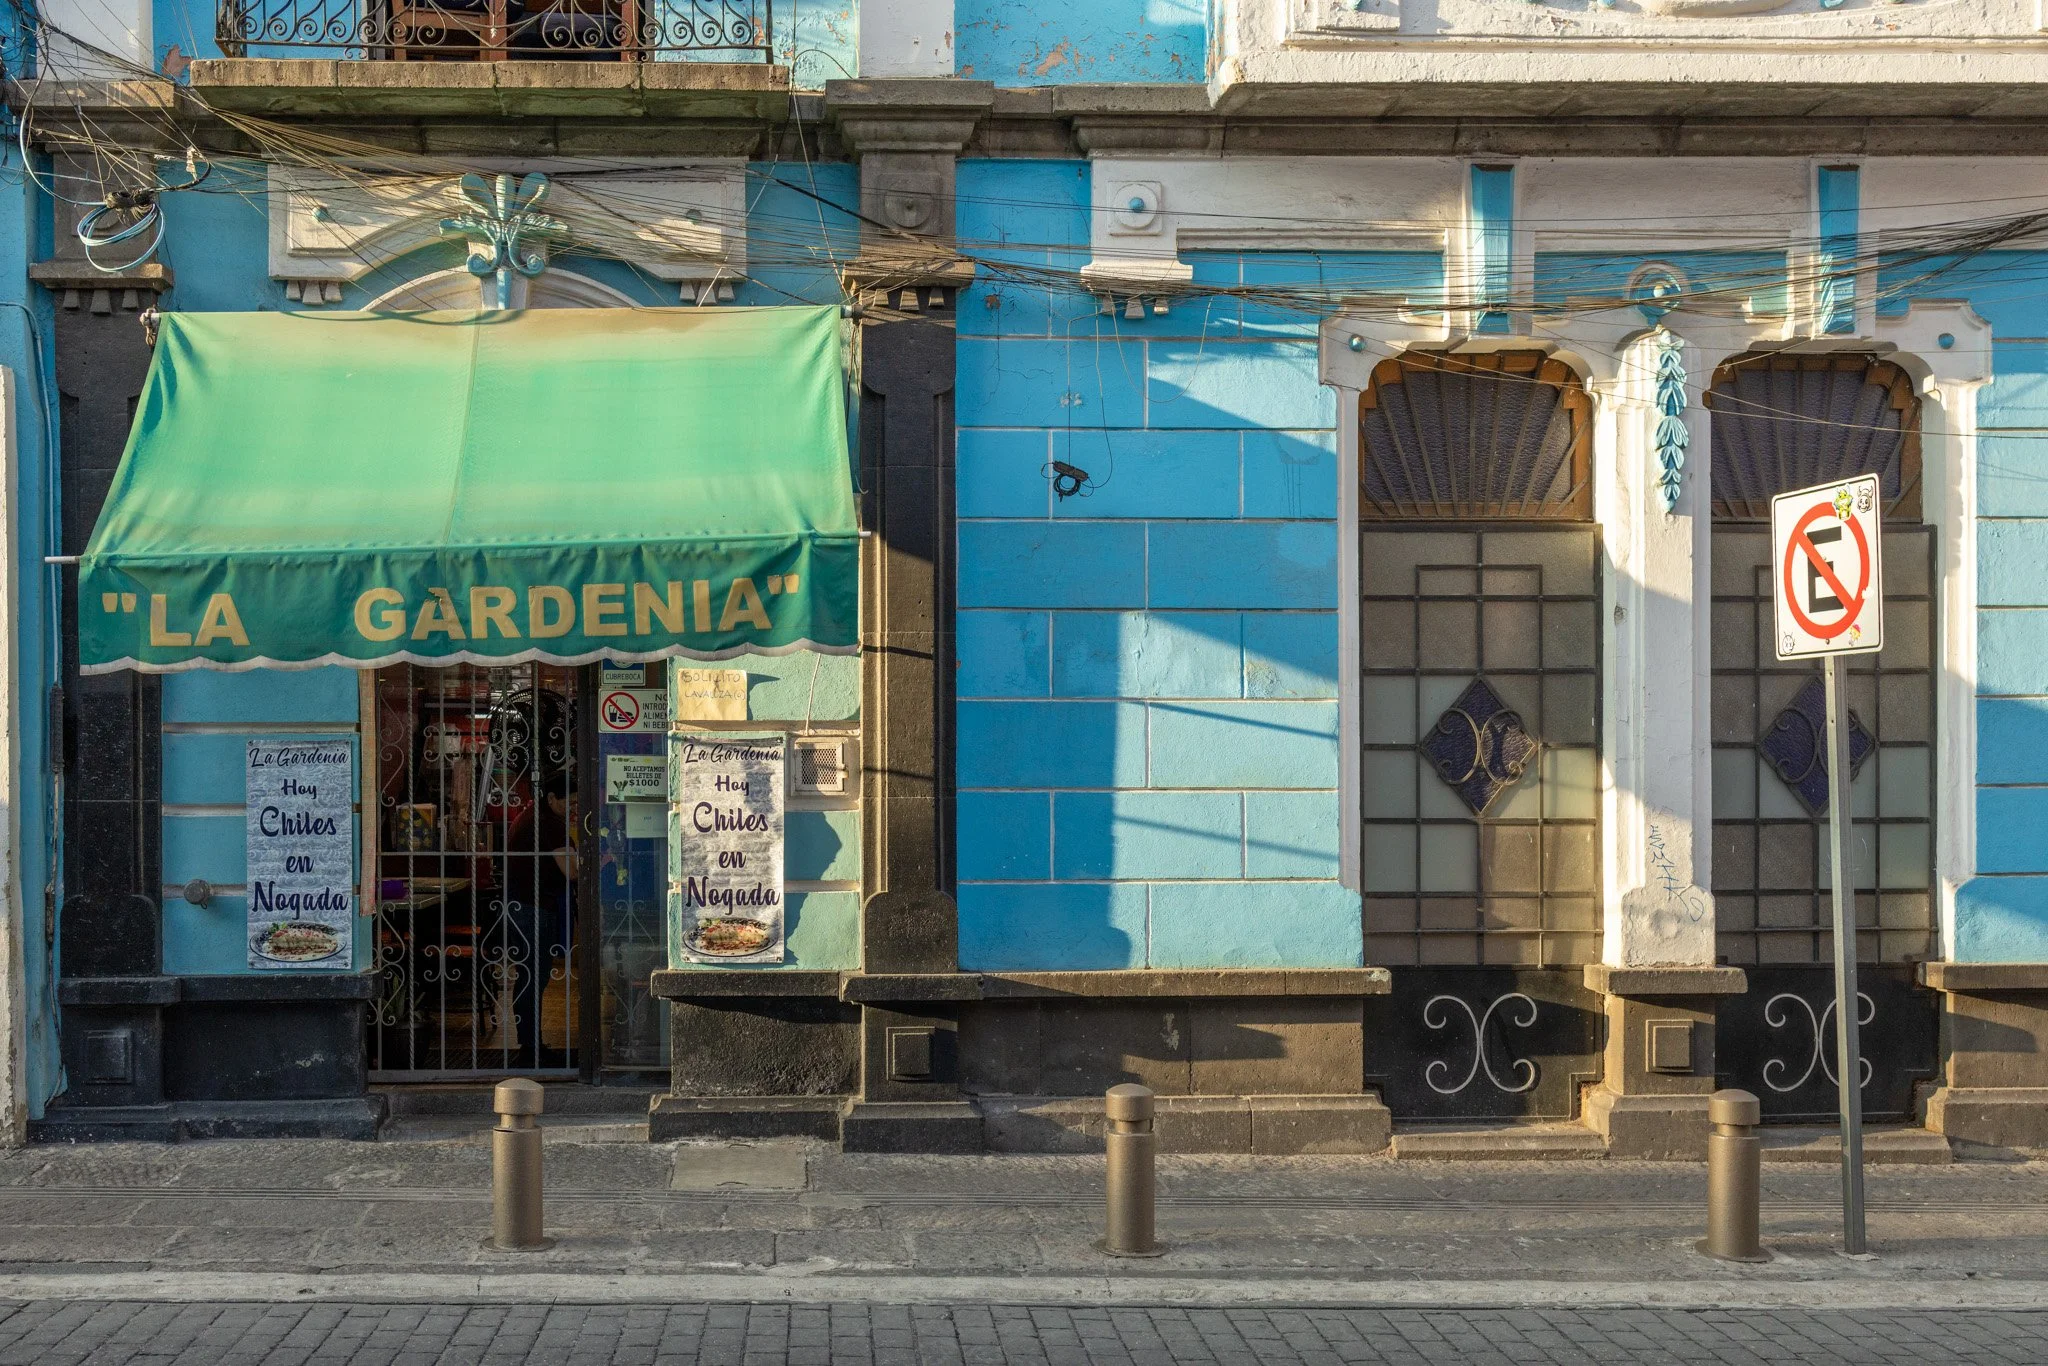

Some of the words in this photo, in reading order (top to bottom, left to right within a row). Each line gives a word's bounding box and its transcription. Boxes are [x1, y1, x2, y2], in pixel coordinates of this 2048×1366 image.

[102, 592, 250, 646] "LA
[354, 574, 799, 642] GARDENIA"
[249, 748, 274, 767] La
[277, 747, 348, 767] Gardenia
[683, 744, 708, 763] La
[711, 744, 780, 763] Gardenia
[281, 779, 317, 799] Hoy
[715, 775, 749, 796] Hoy
[260, 806, 337, 837] Chiles
[693, 801, 769, 833] Chiles
[285, 856, 314, 873] en
[719, 851, 746, 868] en
[252, 881, 348, 920] Nogada
[686, 876, 780, 916] Nogada
